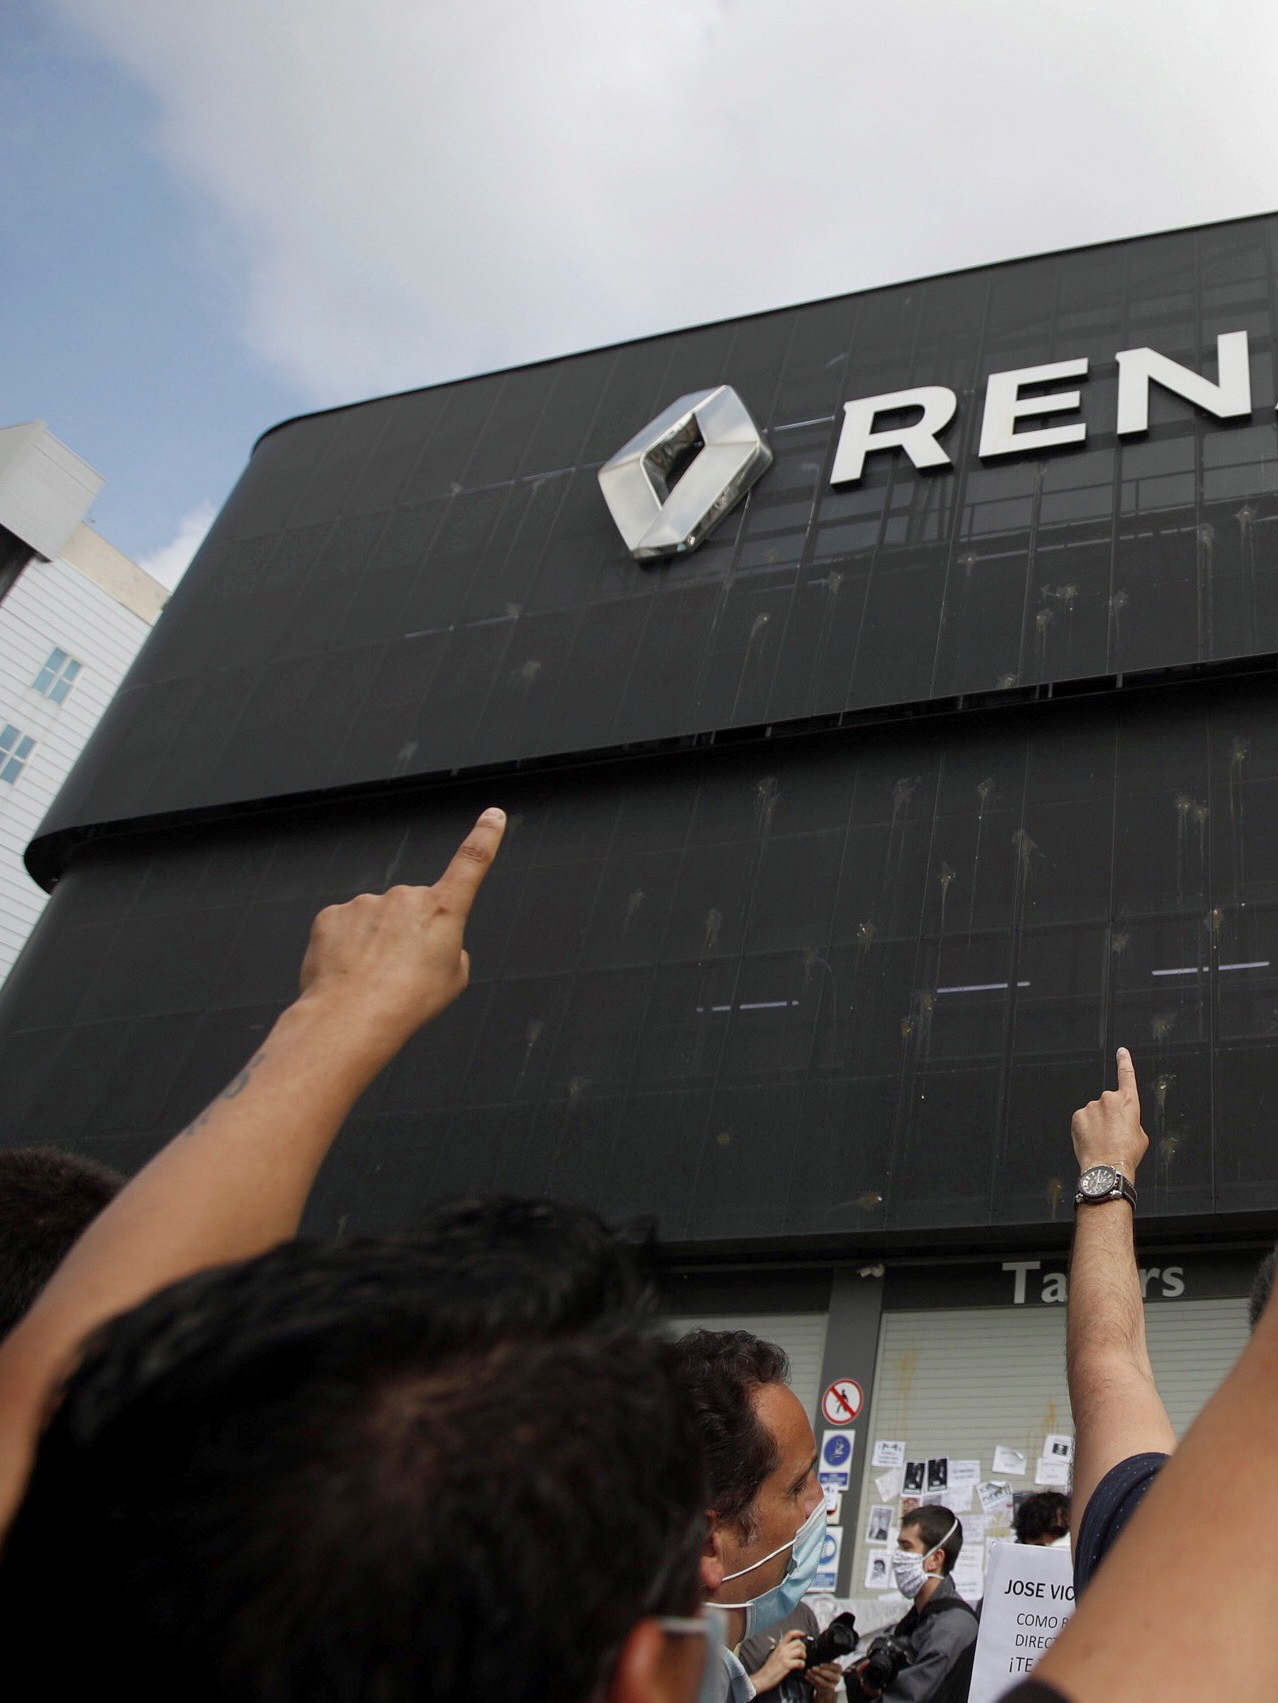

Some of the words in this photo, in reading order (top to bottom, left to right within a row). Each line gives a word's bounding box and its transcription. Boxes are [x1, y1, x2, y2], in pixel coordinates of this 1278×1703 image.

[1002, 1261, 1185, 1304] Tars
[1004, 1579, 1046, 1598] JOSE
[1016, 1613, 1058, 1629] COMO
